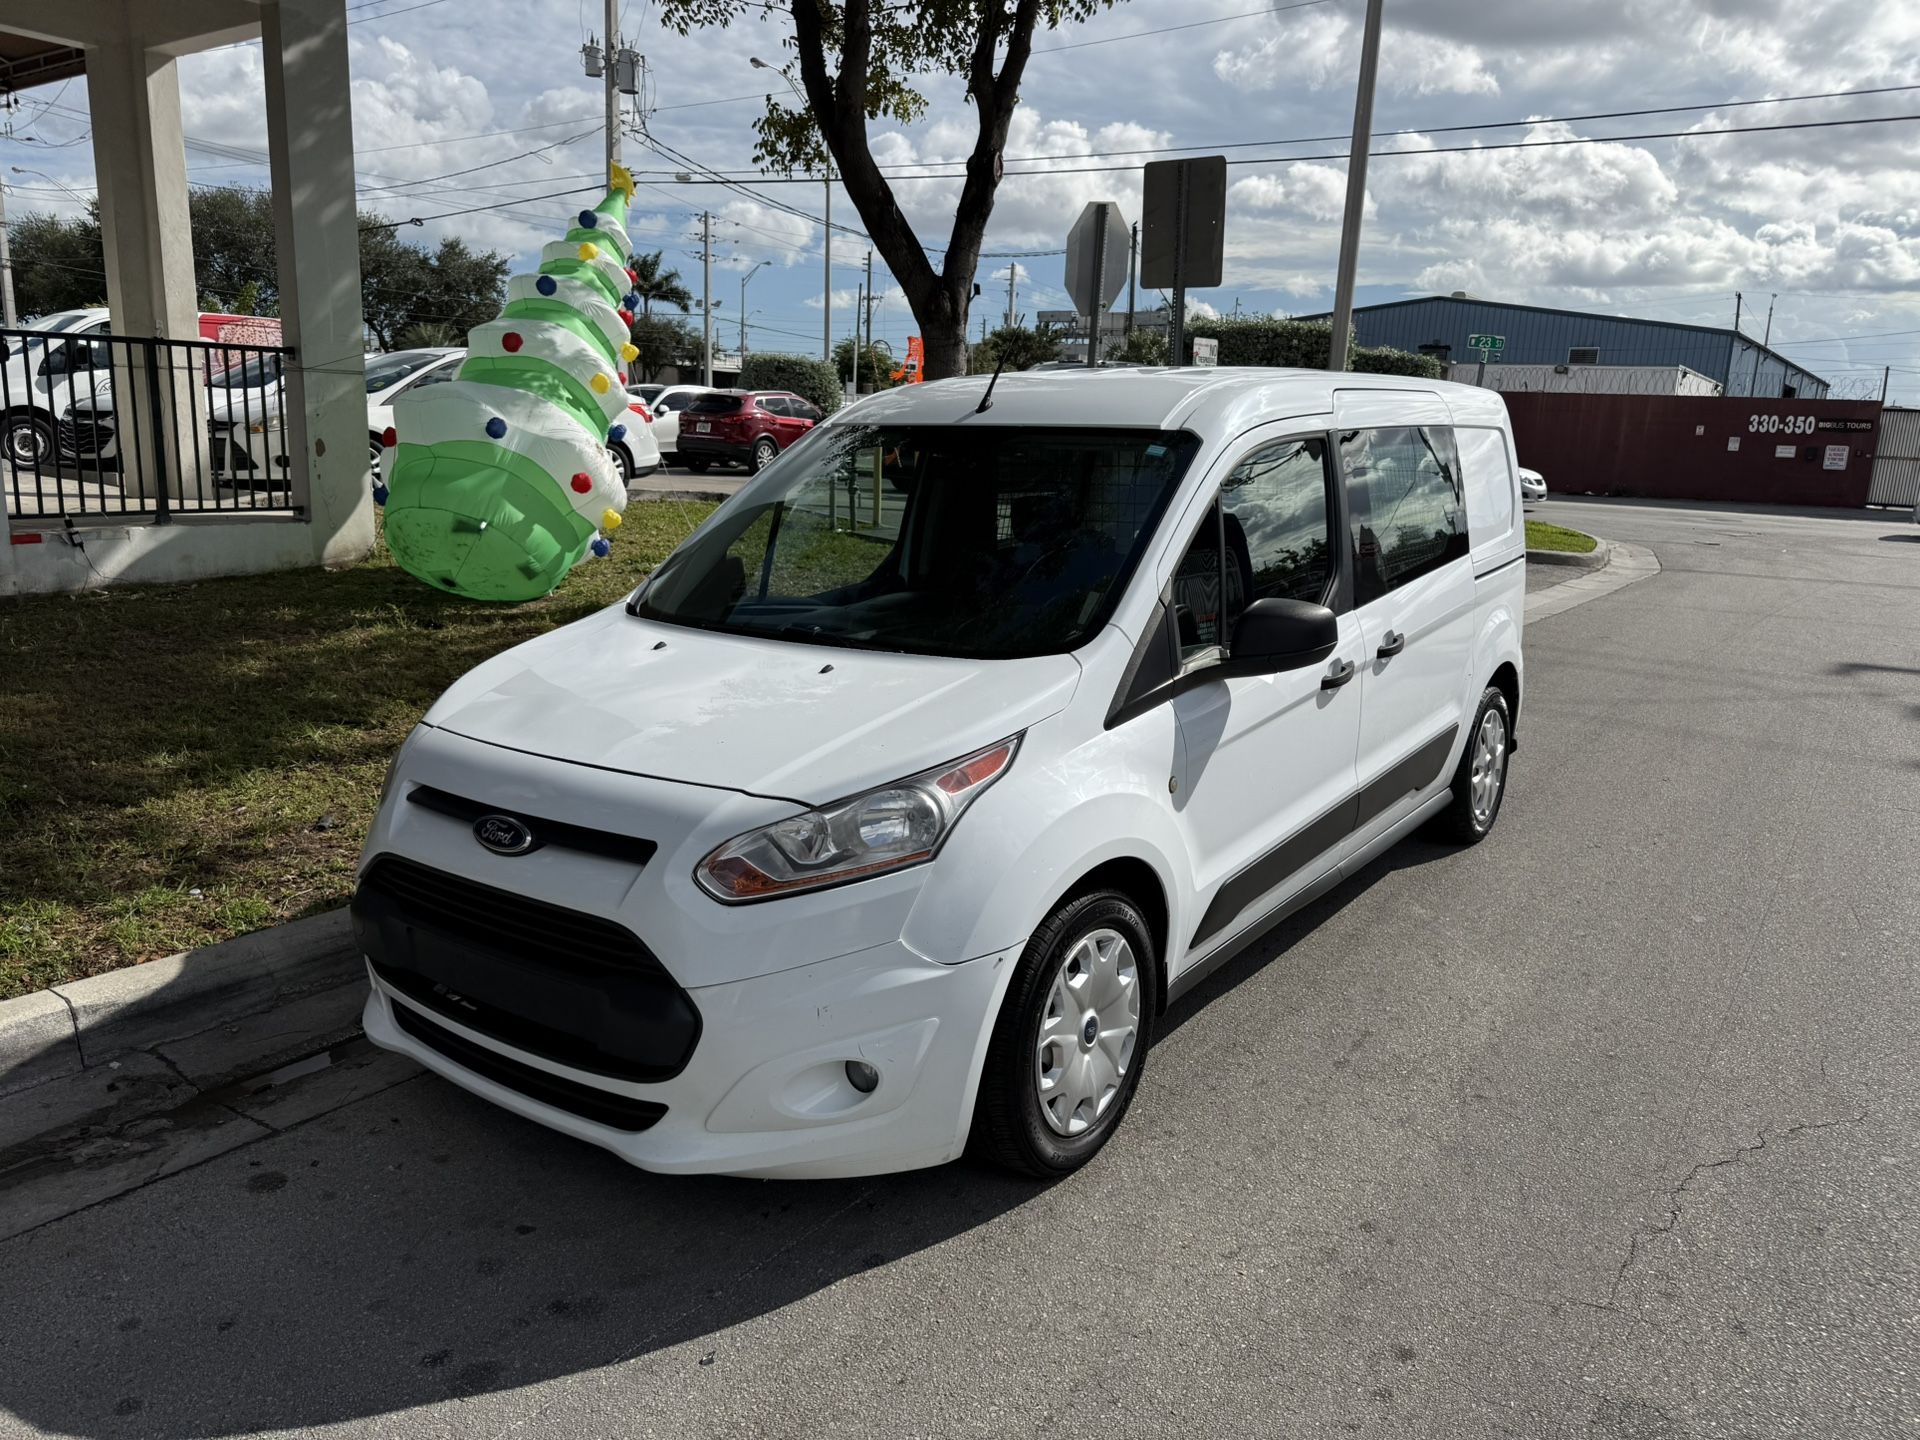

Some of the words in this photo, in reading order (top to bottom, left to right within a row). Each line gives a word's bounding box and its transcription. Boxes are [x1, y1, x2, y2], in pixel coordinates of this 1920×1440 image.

[1479, 336, 1491, 348] 23
[1496, 339, 1503, 348] ST
[1748, 414, 1816, 435] 330-350
[1846, 422, 1872, 430] TOURS
[481, 820, 515, 845] Ford
